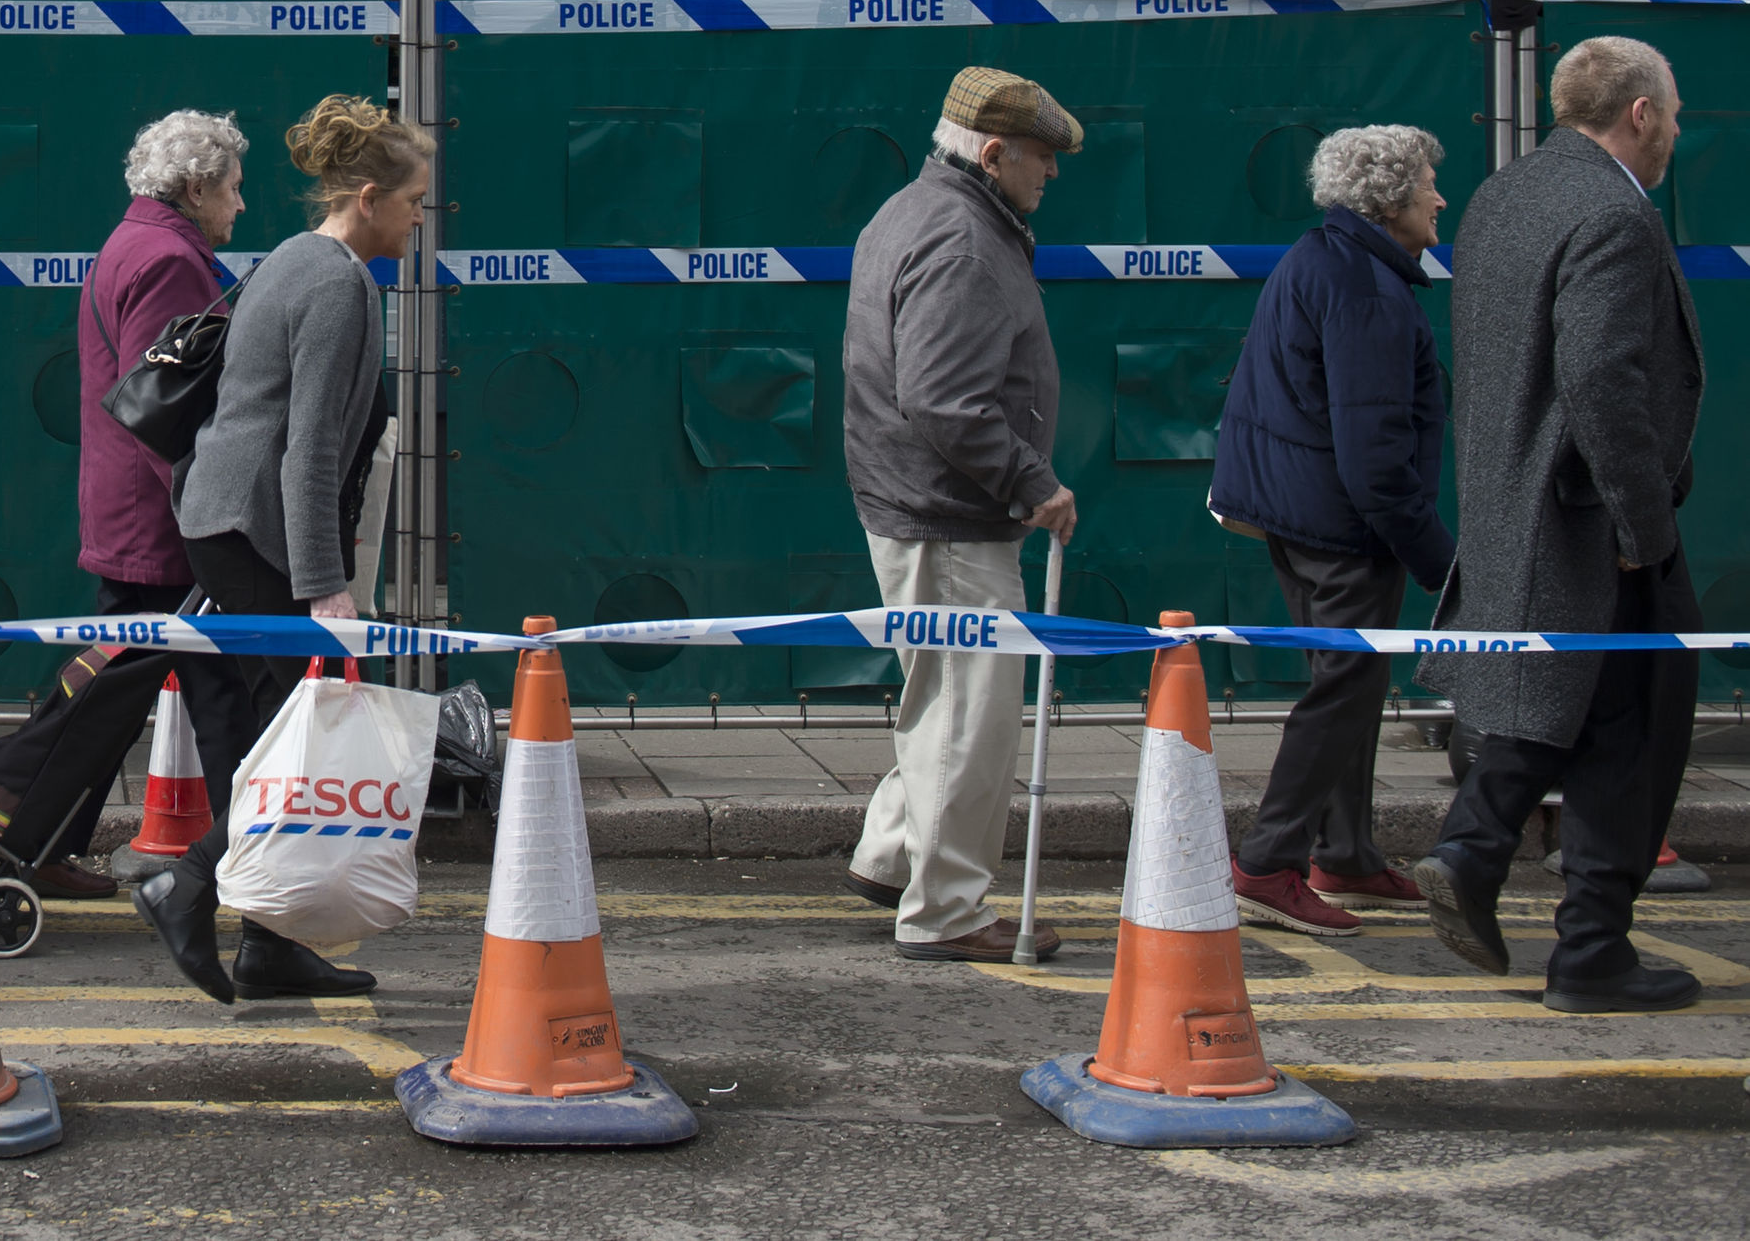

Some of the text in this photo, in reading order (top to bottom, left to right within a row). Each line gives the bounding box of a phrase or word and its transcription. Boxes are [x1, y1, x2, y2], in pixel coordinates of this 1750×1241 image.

[271, 5, 366, 30] POLICE
[559, 2, 654, 28] POLICE
[470, 255, 550, 281] POLICE
[688, 253, 768, 279] POLICE
[1124, 250, 1202, 276] POLICE
[884, 611, 998, 648] POLICE
[248, 777, 410, 821] TESCO
